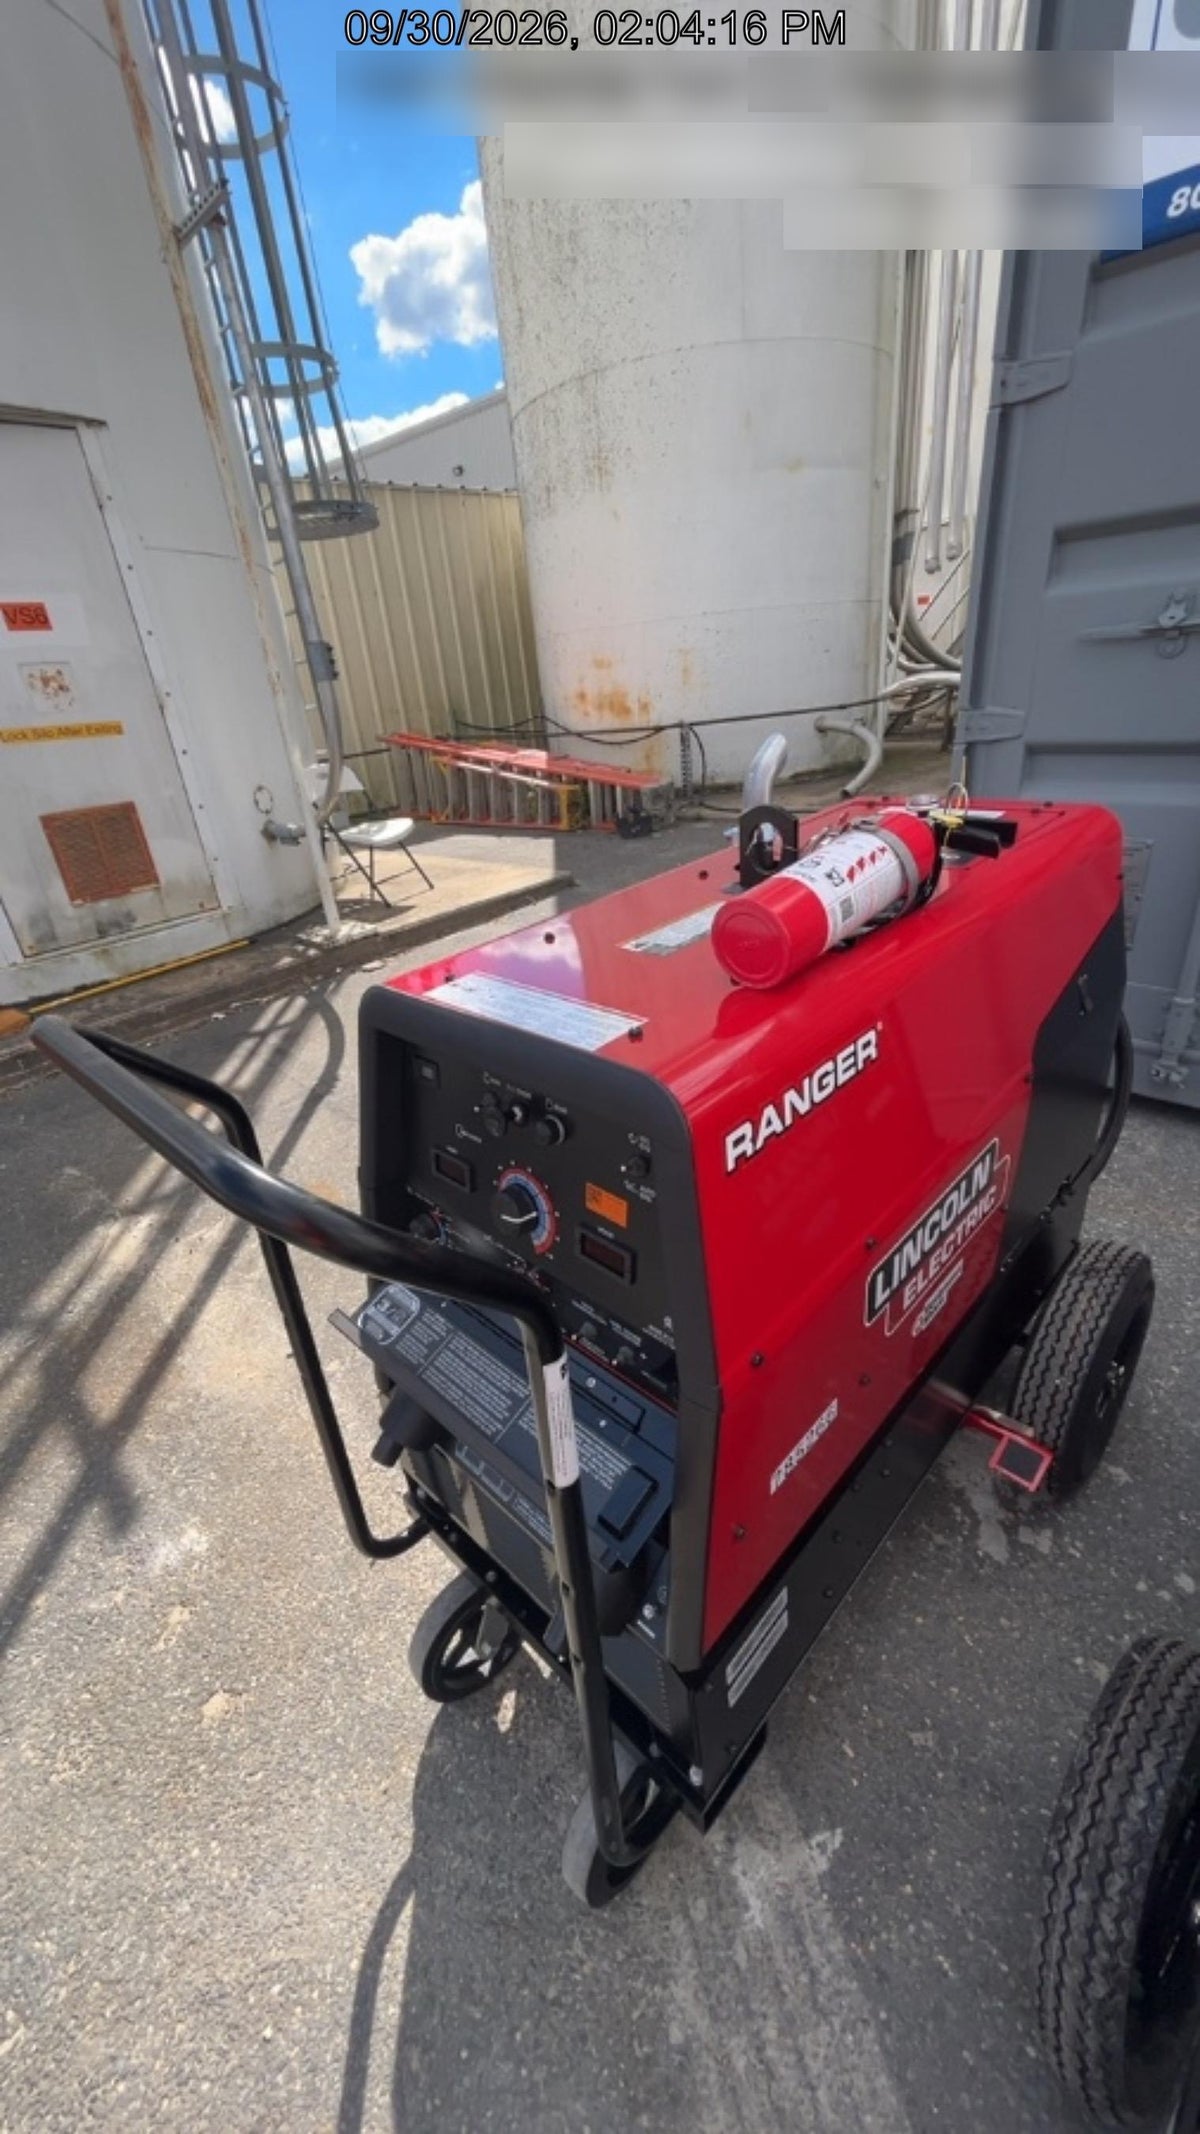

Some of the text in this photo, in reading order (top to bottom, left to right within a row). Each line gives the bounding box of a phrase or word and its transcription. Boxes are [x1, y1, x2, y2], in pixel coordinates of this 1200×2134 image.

[725, 1030, 878, 1173] RANGER
[874, 1151, 992, 1310] LINCOLN
[903, 1185, 998, 1310] ELECTRIC
